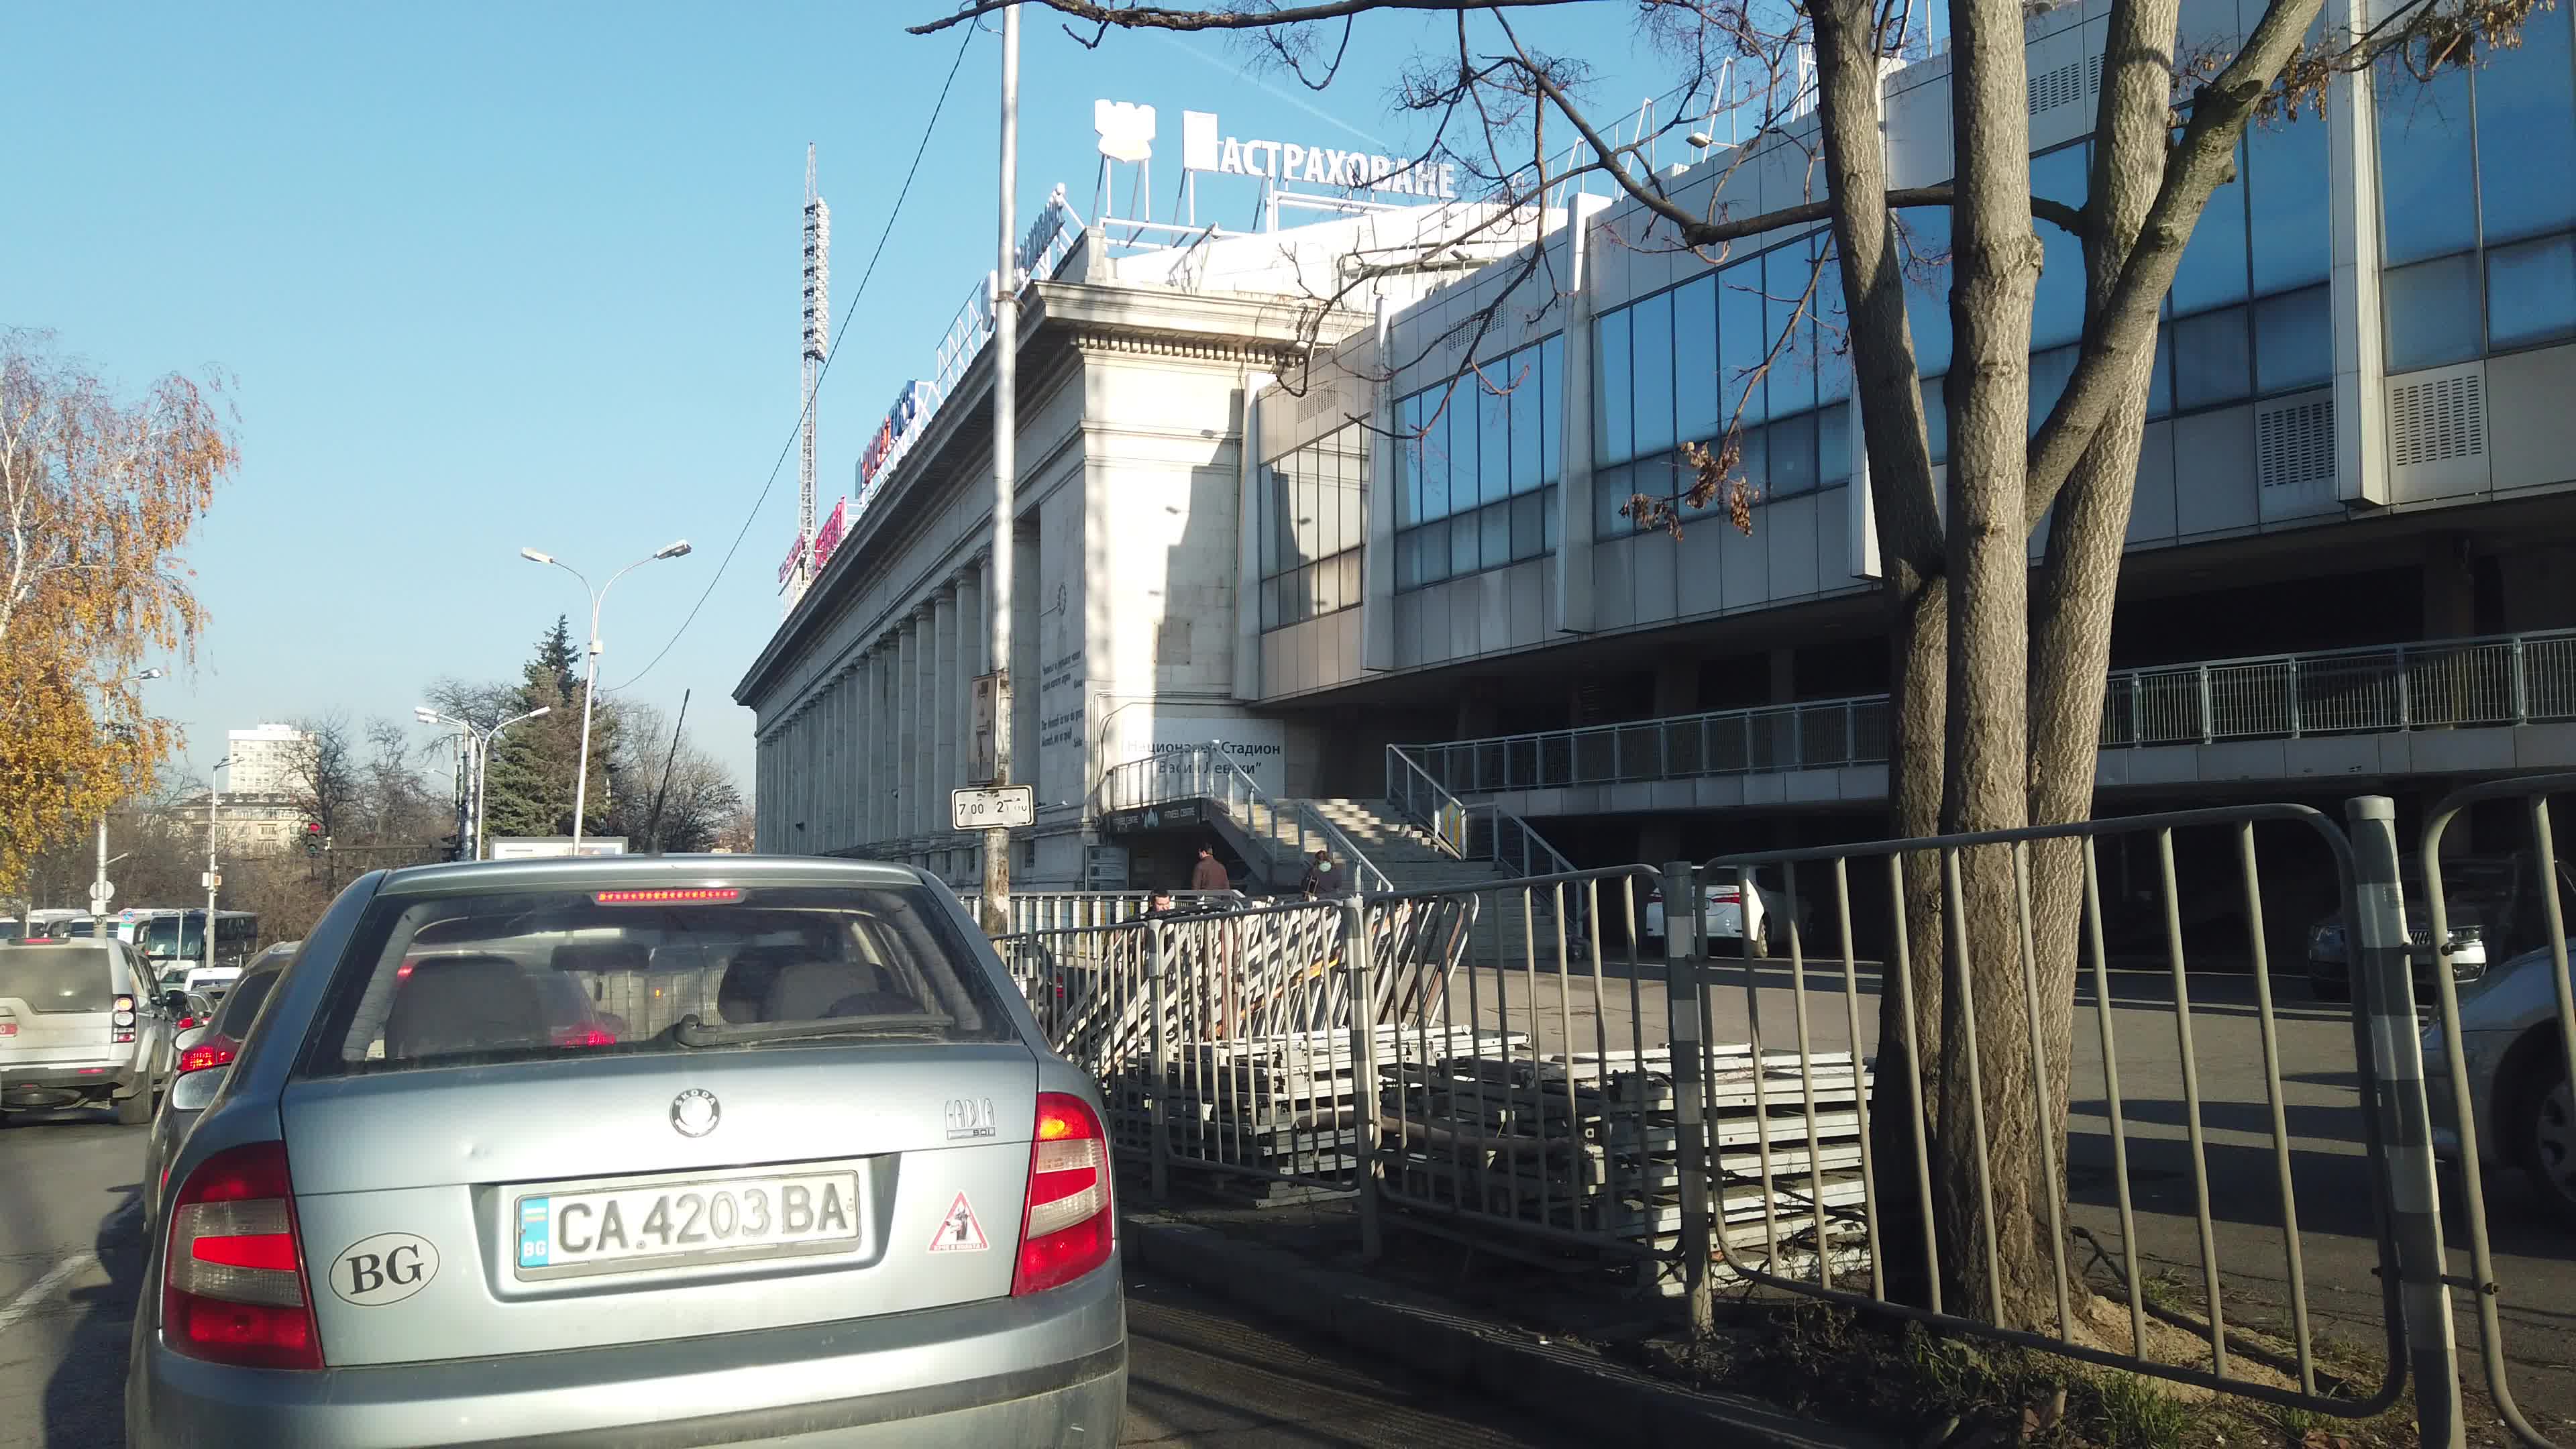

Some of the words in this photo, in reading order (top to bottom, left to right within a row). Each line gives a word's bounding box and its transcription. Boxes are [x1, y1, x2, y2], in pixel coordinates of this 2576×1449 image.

[1220, 136, 1455, 199] АСТРАХОВАНЕ
[1221, 741, 1281, 756] Стадион
[945, 1097, 995, 1128] FABIA
[523, 1239, 547, 1256] BG
[345, 1244, 425, 1295] BG
